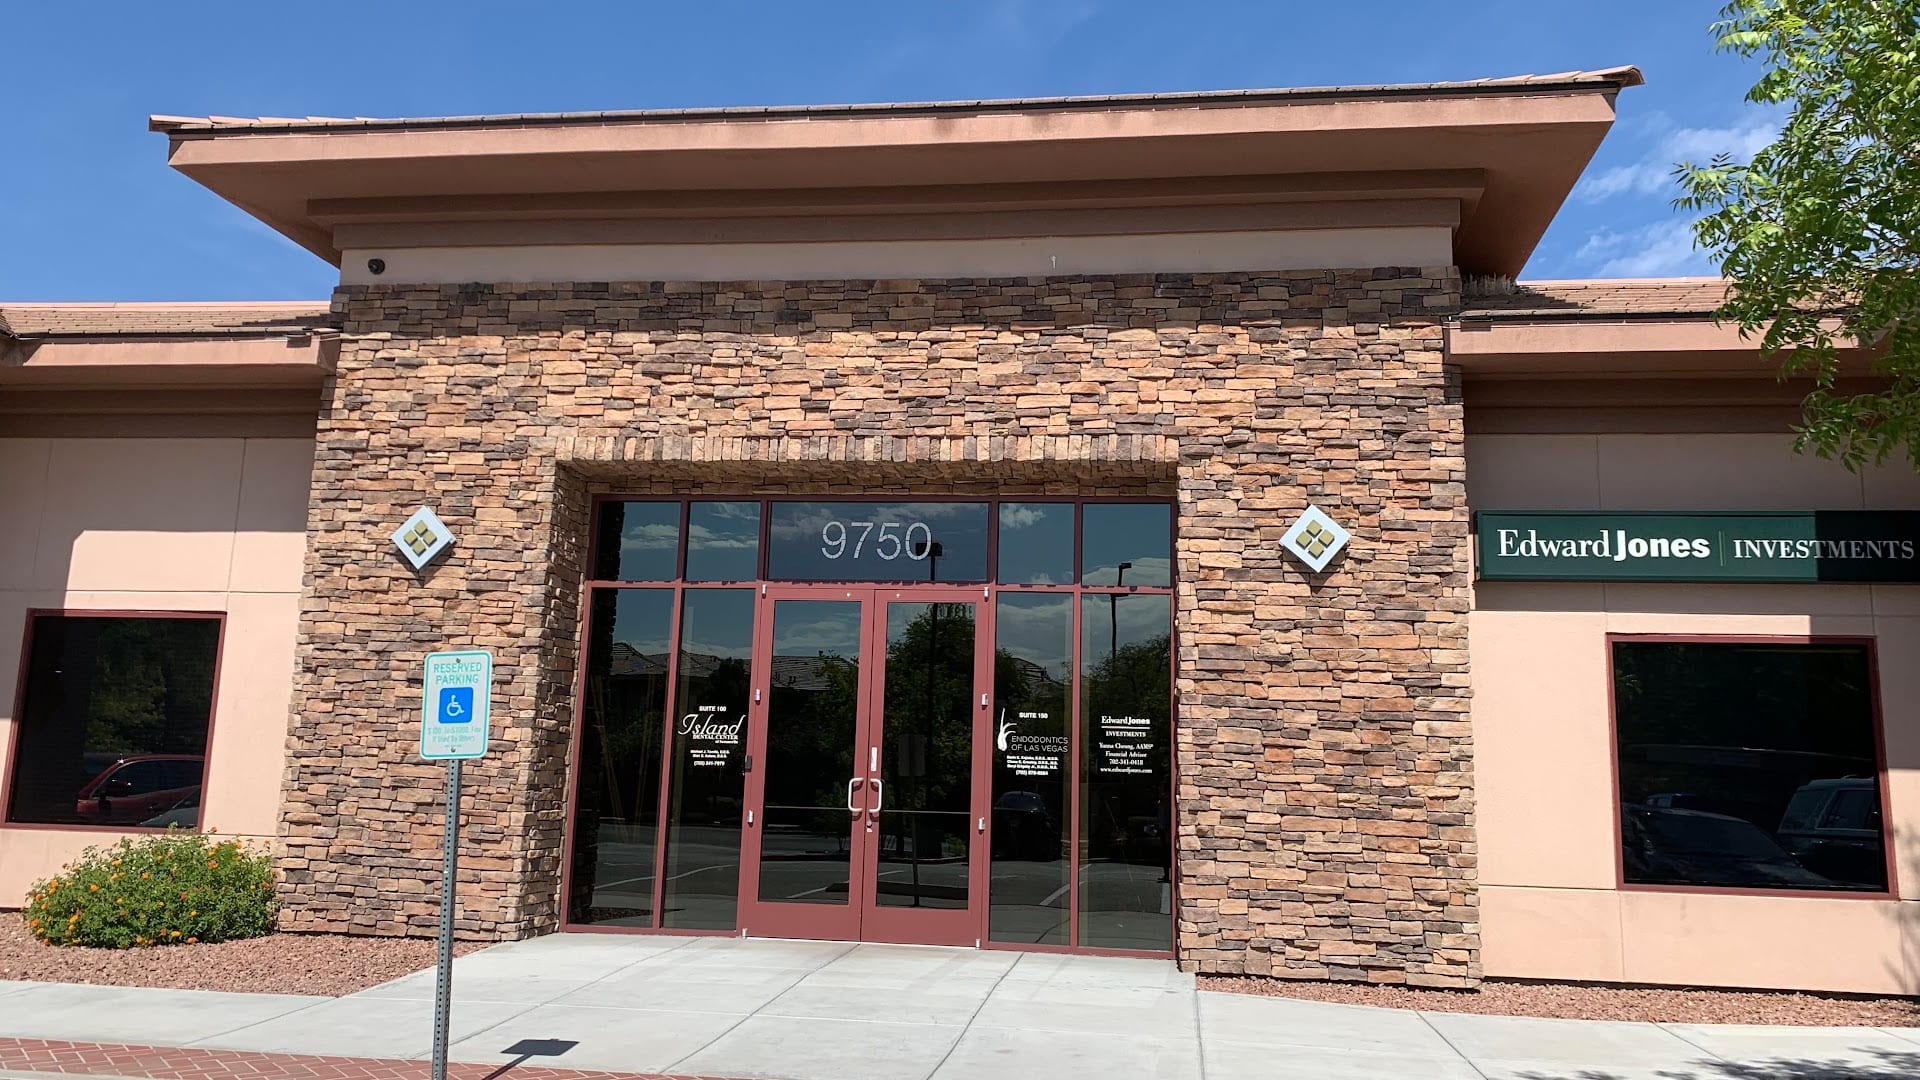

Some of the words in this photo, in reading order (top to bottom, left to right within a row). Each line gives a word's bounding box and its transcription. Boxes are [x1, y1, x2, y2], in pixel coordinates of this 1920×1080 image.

[821, 521, 932, 561] 9750
[1733, 538, 1915, 560] INVESTMENTS
[433, 662, 482, 673] RESERVED
[435, 674, 479, 685] PARKING
[677, 713, 747, 735] Island
[1105, 730, 1147, 738] INVESTMENTS
[1011, 735, 1069, 745] ENDODONTICS
[1011, 743, 1023, 751] OF
[1024, 744, 1040, 752] LAS
[1041, 745, 1069, 753] VEGAS
